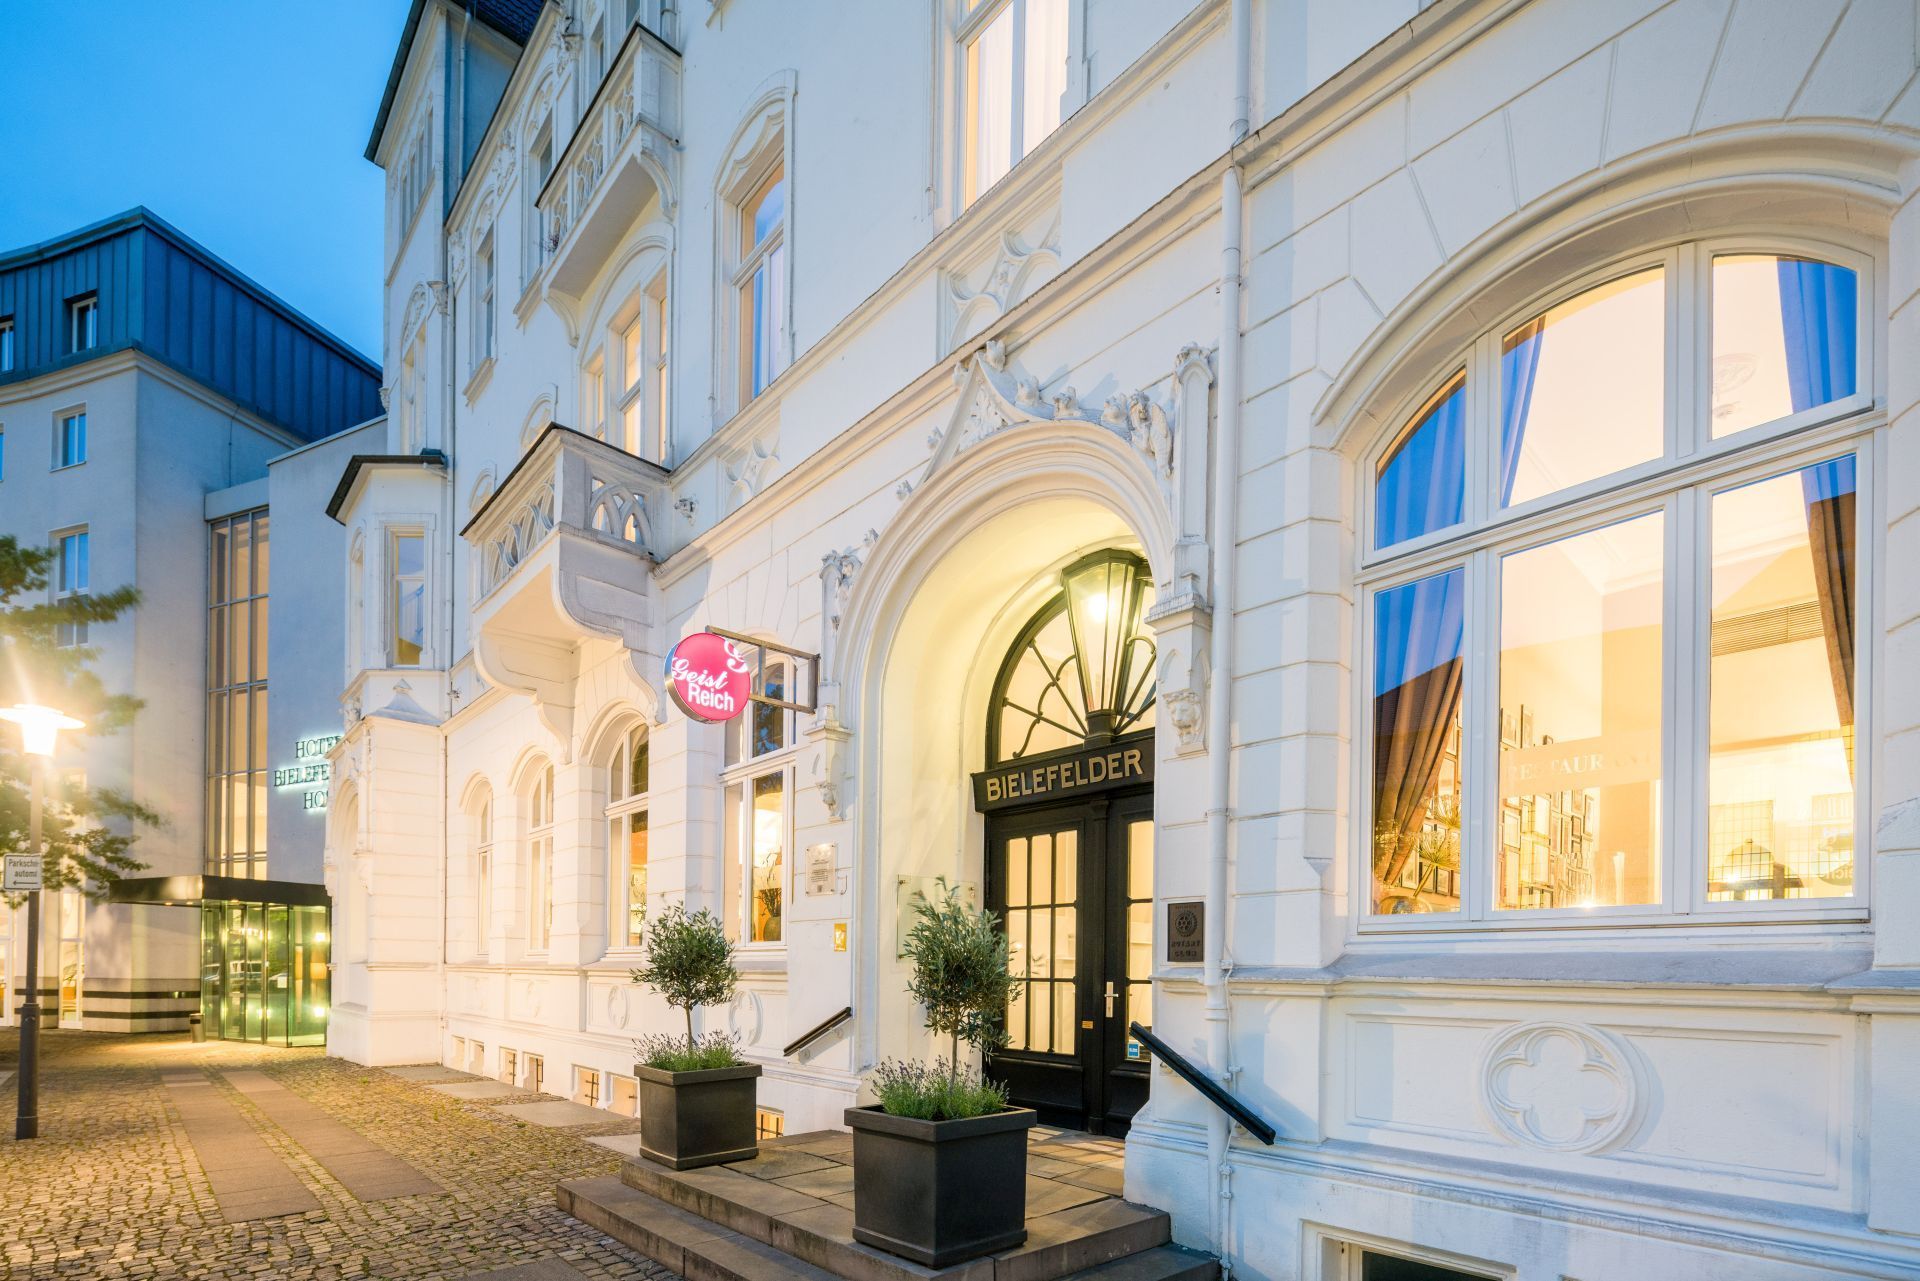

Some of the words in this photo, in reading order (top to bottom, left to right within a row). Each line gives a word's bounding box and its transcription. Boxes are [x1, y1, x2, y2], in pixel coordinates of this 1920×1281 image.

[672, 657, 728, 690] Geist
[687, 682, 735, 713] Reich
[295, 735, 342, 759] HOTE
[986, 749, 1144, 802] BIELEFELDER
[303, 789, 329, 810] HO
